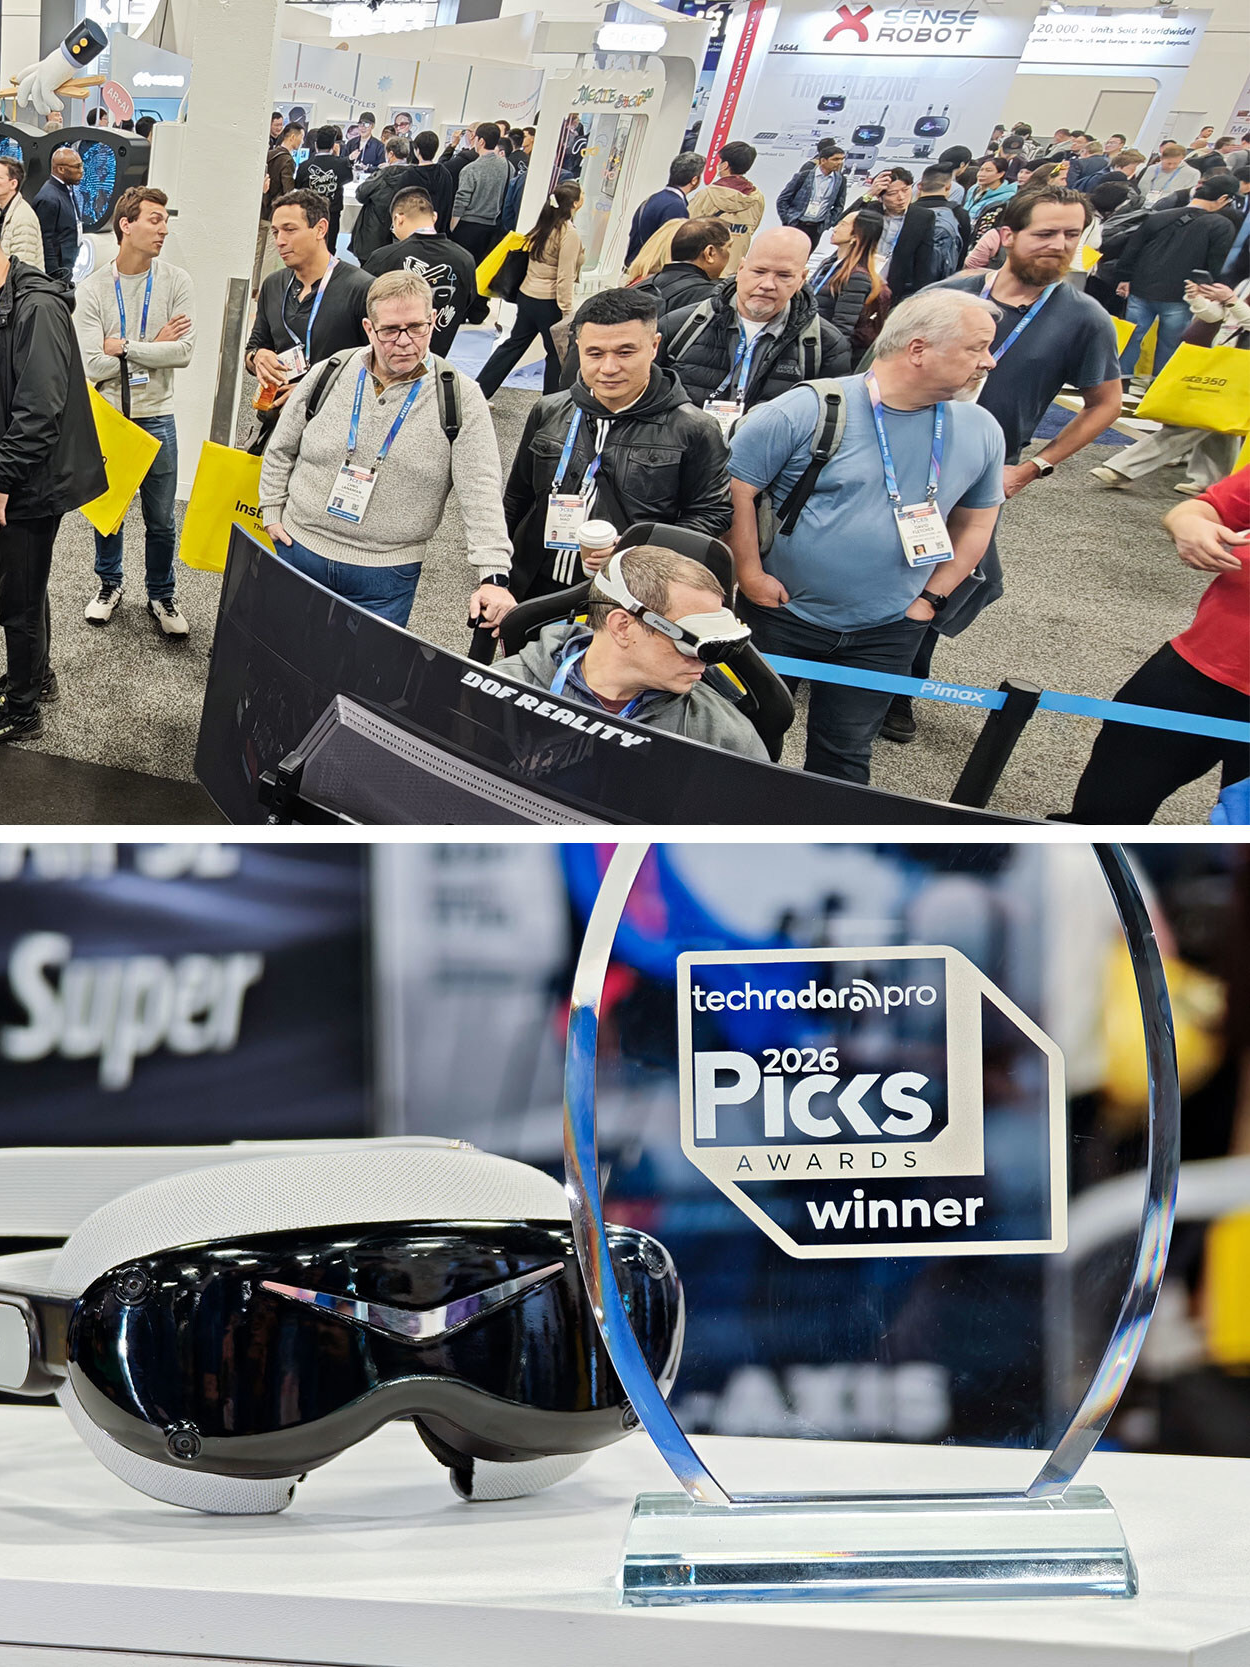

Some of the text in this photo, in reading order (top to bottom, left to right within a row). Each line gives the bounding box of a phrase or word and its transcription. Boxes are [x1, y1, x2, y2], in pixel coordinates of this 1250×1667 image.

[883, 9, 979, 26] SENSE
[773, 43, 799, 51] 14644
[876, 27, 972, 44] ROBOT
[106, 87, 131, 113] AR+AI
[333, 90, 377, 109] LIFESTYLES
[919, 681, 986, 703] Pimax
[460, 671, 647, 748] DOF REALITY
[691, 979, 938, 1015] techradar pro
[0, 930, 264, 1092] Super
[762, 1047, 840, 1074] 2026
[736, 1151, 918, 1172] AWARDS
[805, 1188, 984, 1230] winner
